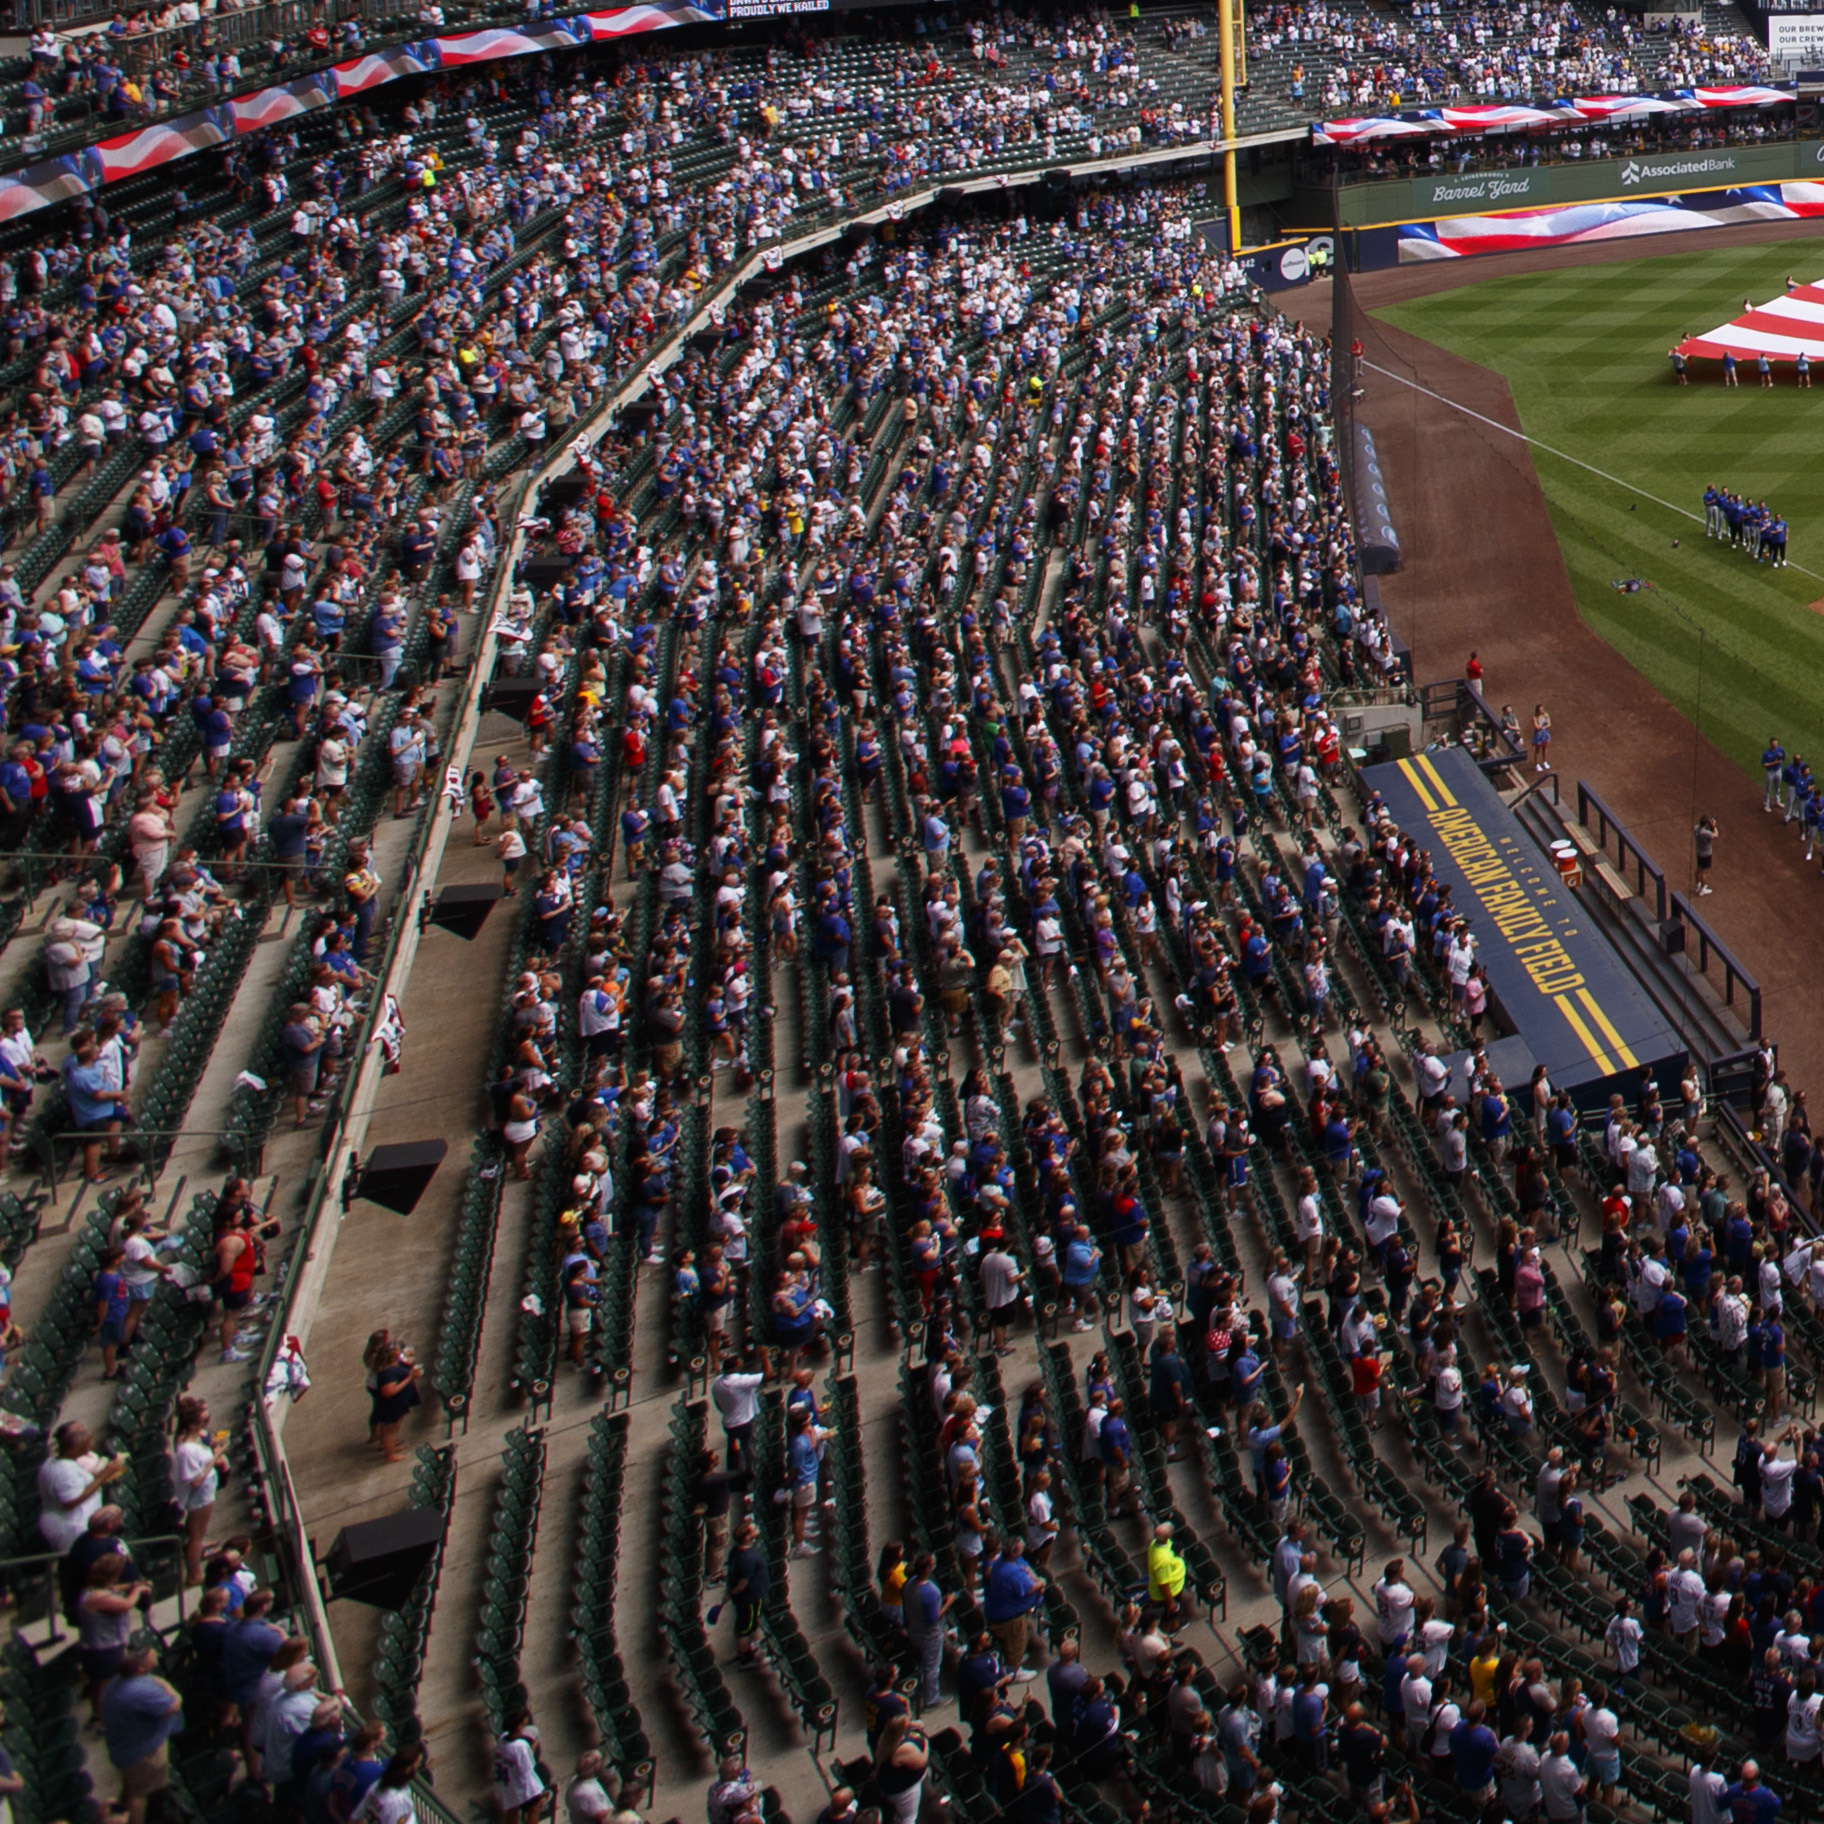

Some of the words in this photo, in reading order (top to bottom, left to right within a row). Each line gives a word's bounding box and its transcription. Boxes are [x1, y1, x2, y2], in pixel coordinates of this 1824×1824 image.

[729, 4, 776, 18] PROUDLY
[777, 2, 792, 14] WE
[793, 0, 829, 12] HAILED
[1779, 25, 1796, 33] OUR
[1799, 35, 1824, 43] CREW
[1433, 185, 1485, 202] Barrel
[1489, 177, 1530, 199] Yard
[1426, 808, 1512, 886] AMERICAN
[1475, 879, 1553, 943] FAMILY
[1515, 939, 1585, 994] FIELD
[1754, 1693, 1774, 1709] 22
